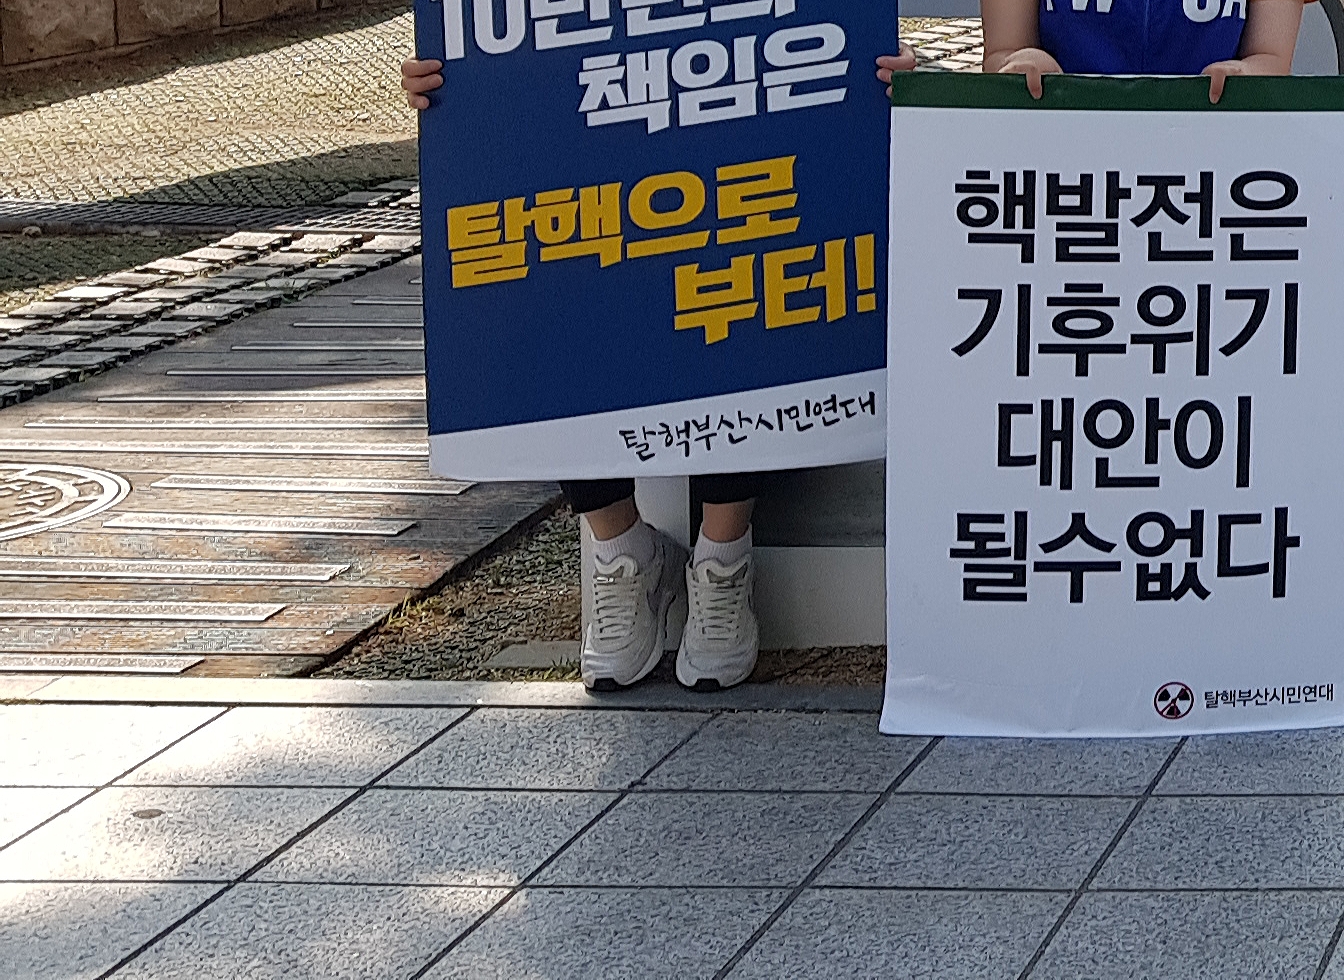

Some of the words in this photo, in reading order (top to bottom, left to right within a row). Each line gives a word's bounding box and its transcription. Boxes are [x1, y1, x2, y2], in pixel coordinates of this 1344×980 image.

[578, 22, 849, 134] 책임은
[446, 155, 801, 289] 탈핵으로
[954, 169, 1308, 264] 핵발전은
[673, 233, 878, 345] 부터!
[951, 282, 1299, 377] 기후위기
[618, 391, 877, 462] 탈핵부산시민연대
[997, 395, 1253, 490] 대안이
[949, 506, 1300, 603] 될수없다
[1204, 683, 1335, 709] 탈핵부산시민연대
